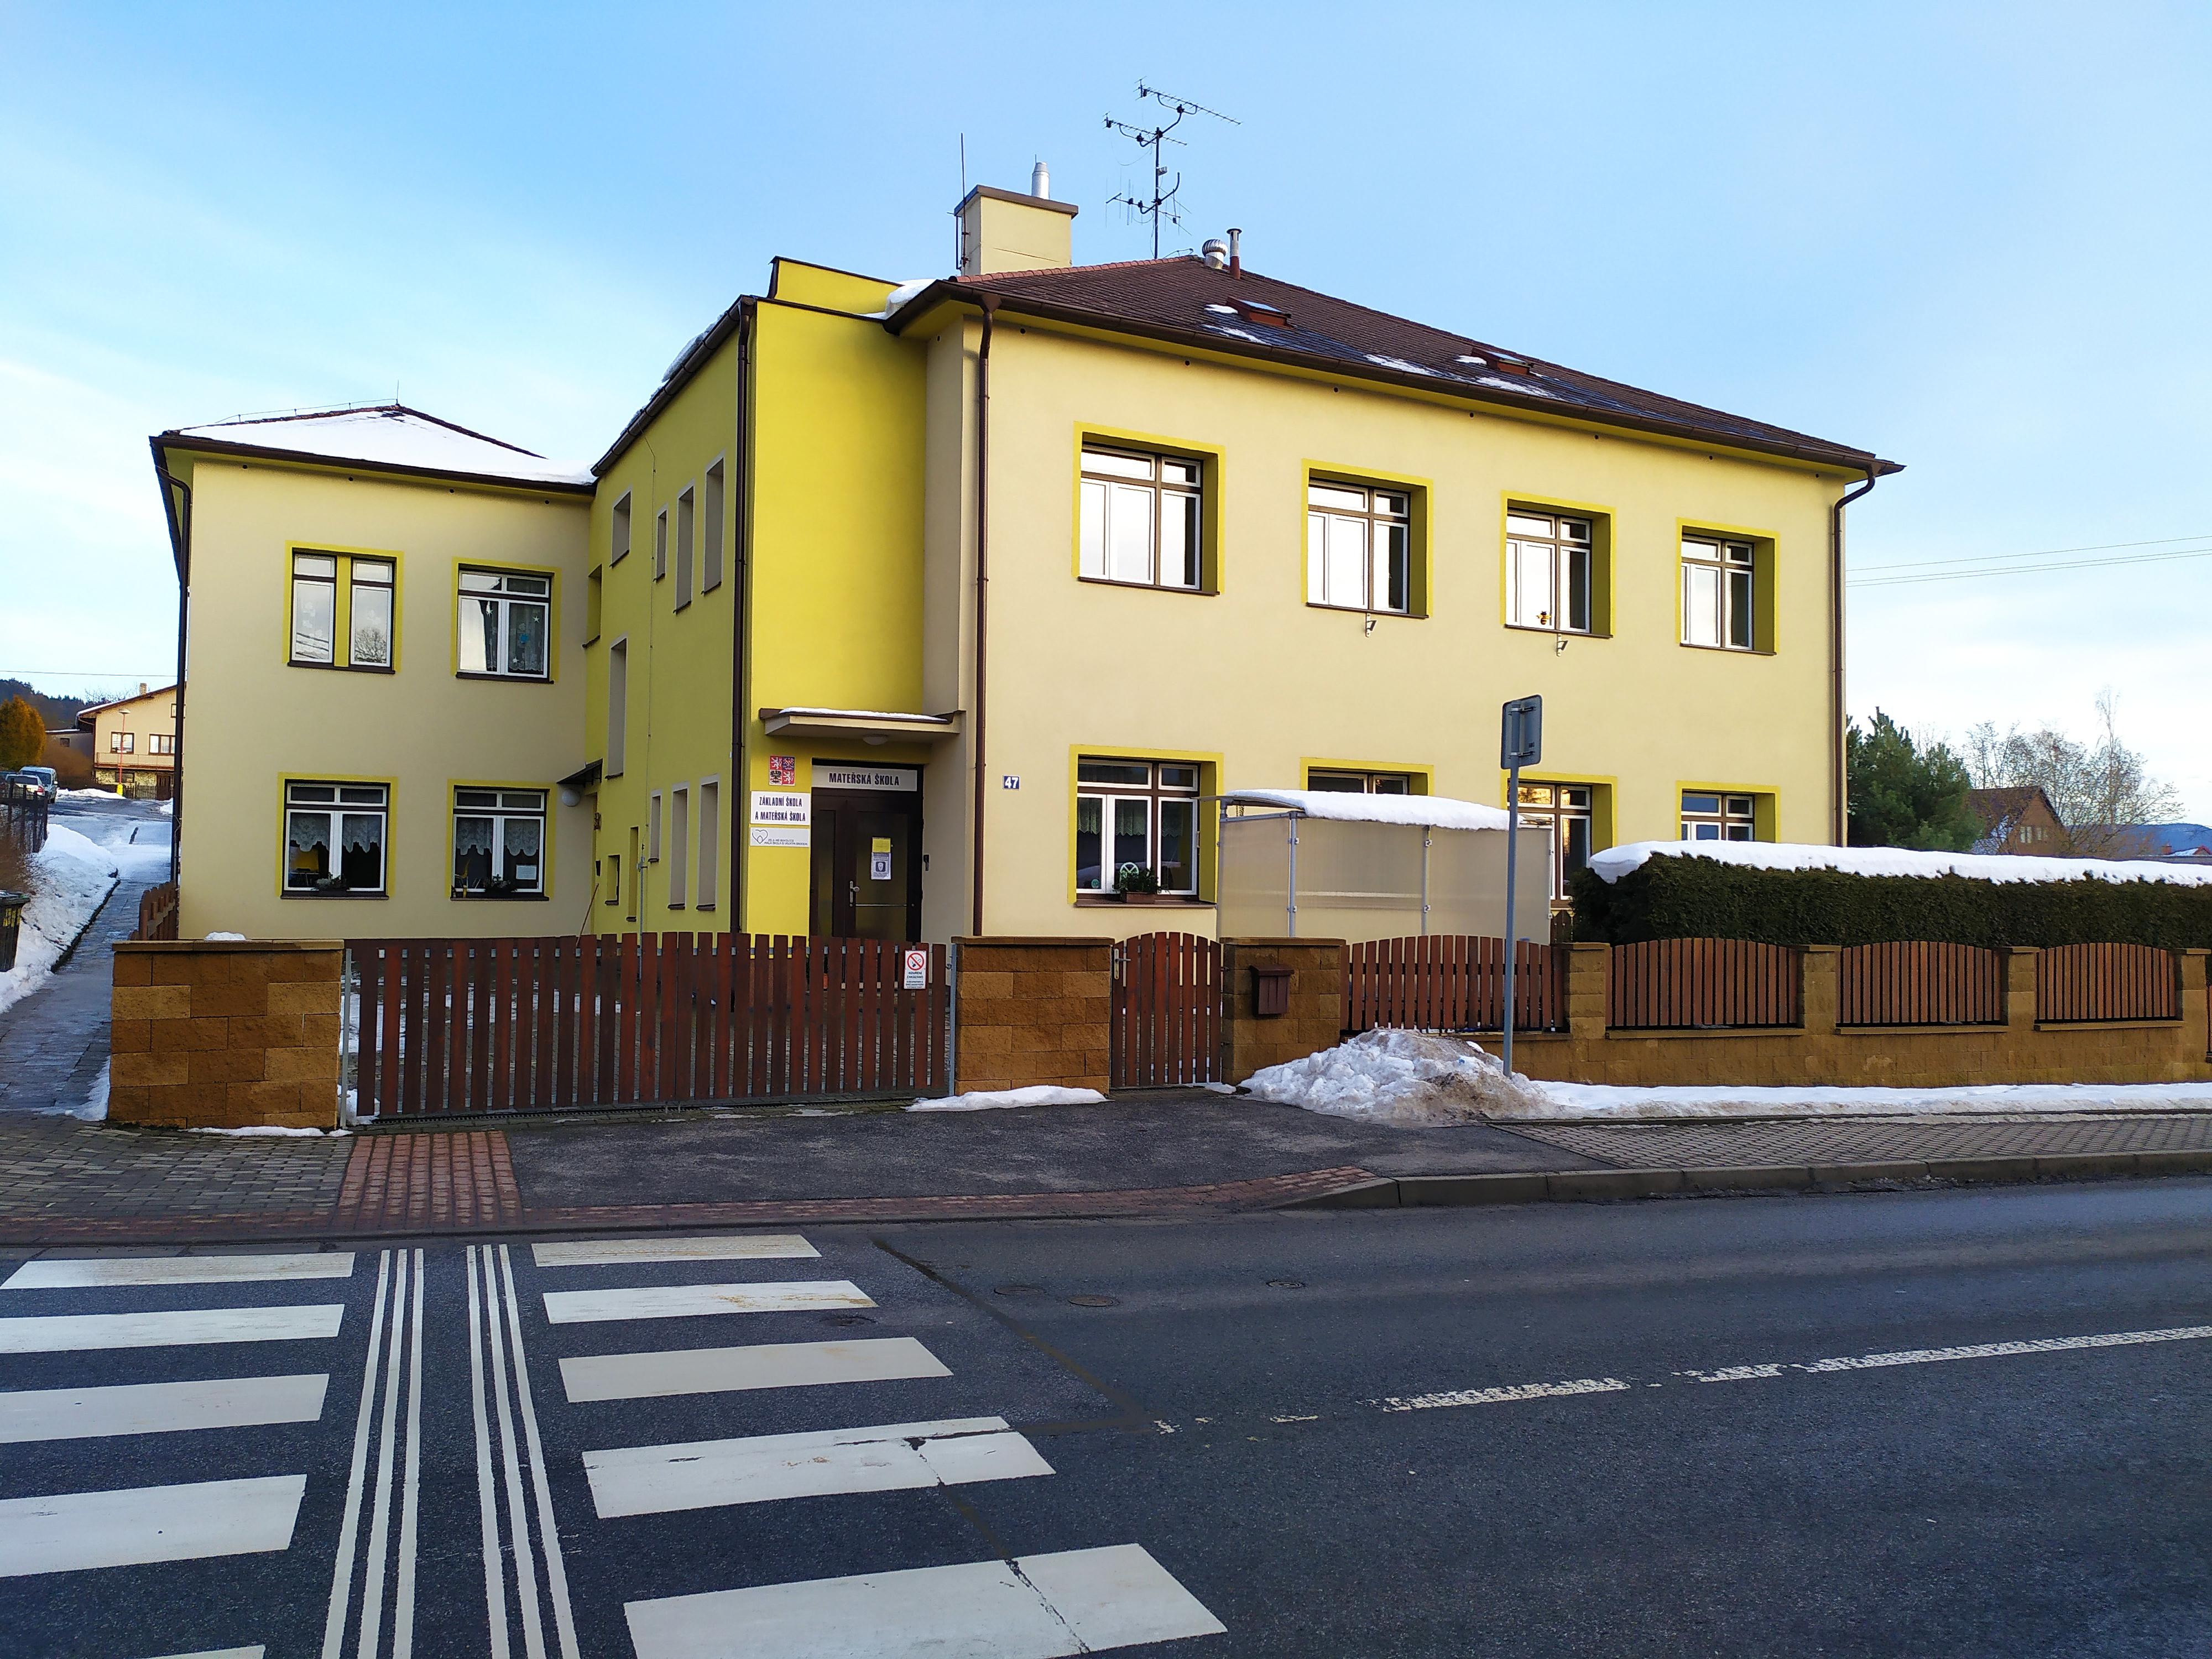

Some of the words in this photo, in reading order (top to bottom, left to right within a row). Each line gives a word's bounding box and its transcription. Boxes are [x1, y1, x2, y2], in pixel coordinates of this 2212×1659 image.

[829, 772, 872, 785] MATEŘSKÁ
[874, 774, 899, 786] ŠKOLA
[1005, 776, 1019, 789] 47
[759, 795, 784, 806] ZÁKLADNÍ
[786, 796, 802, 807] ŠKOLA
[755, 811, 758, 820] A
[760, 810, 787, 821] MATEŘSKÁ
[790, 811, 806, 822] ŠKOLA
